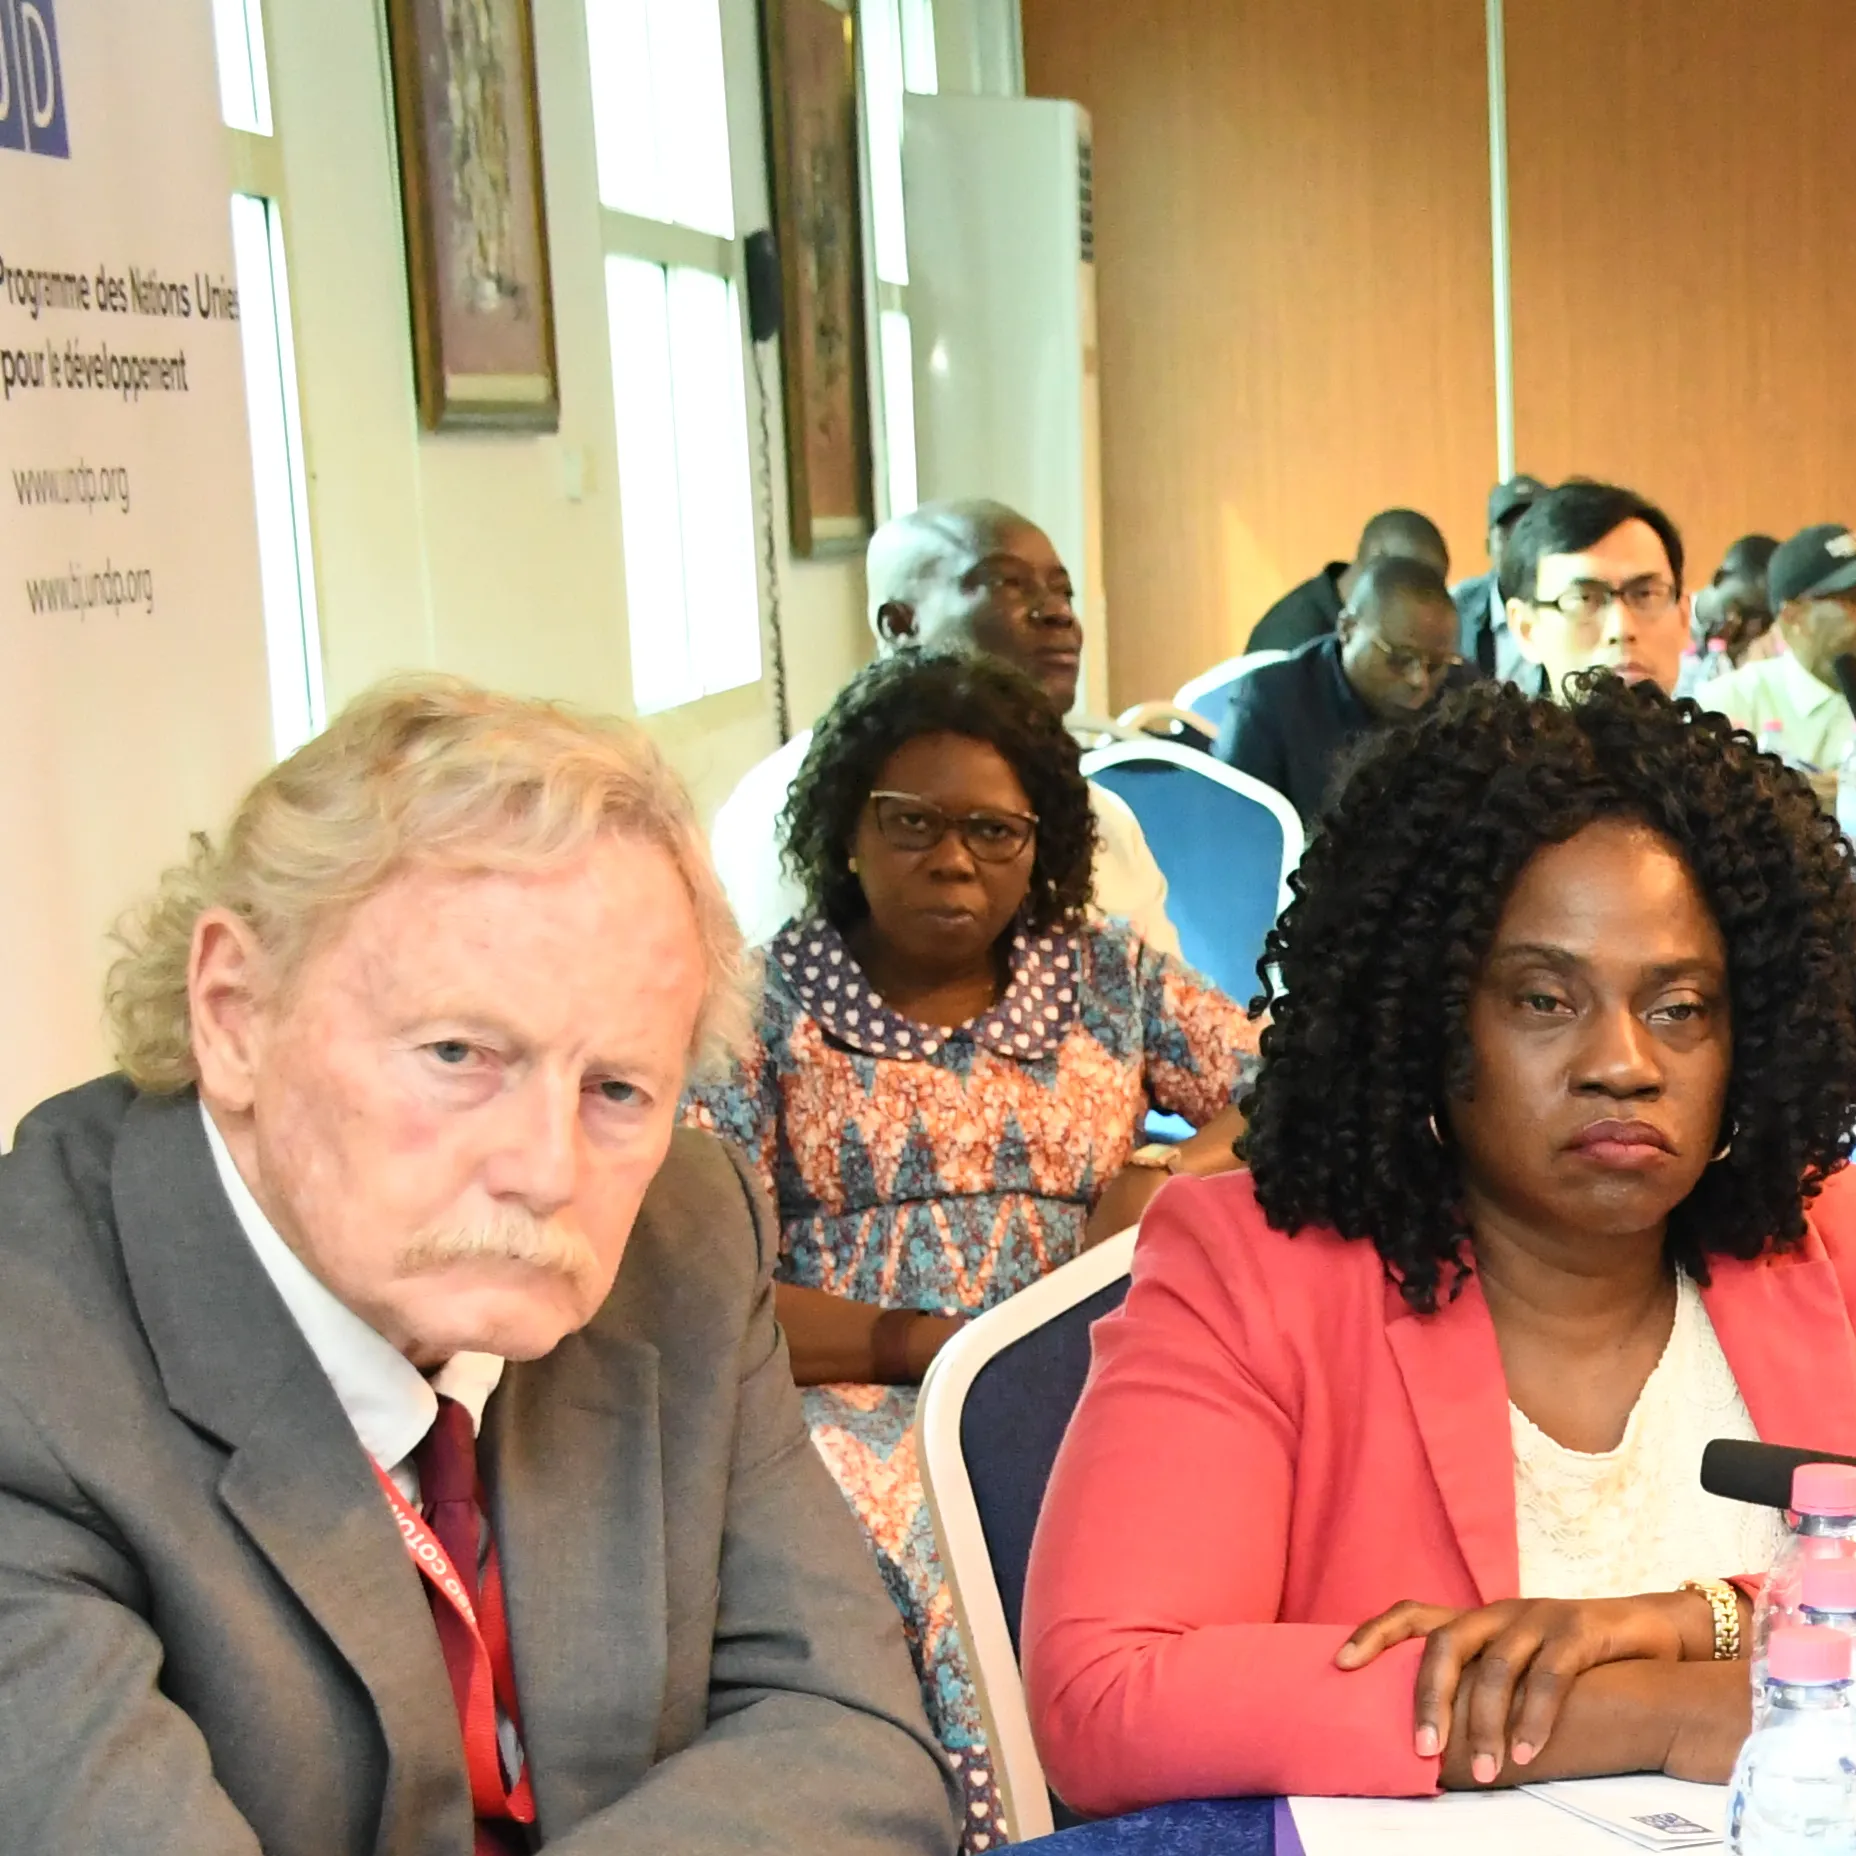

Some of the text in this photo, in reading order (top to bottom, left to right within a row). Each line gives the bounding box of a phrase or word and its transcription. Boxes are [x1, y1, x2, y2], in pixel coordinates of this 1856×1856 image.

[95, 263, 128, 313] des
[128, 265, 191, 319] Nations
[0, 336, 189, 403] pour le développement
[12, 456, 131, 516] www.undp.org
